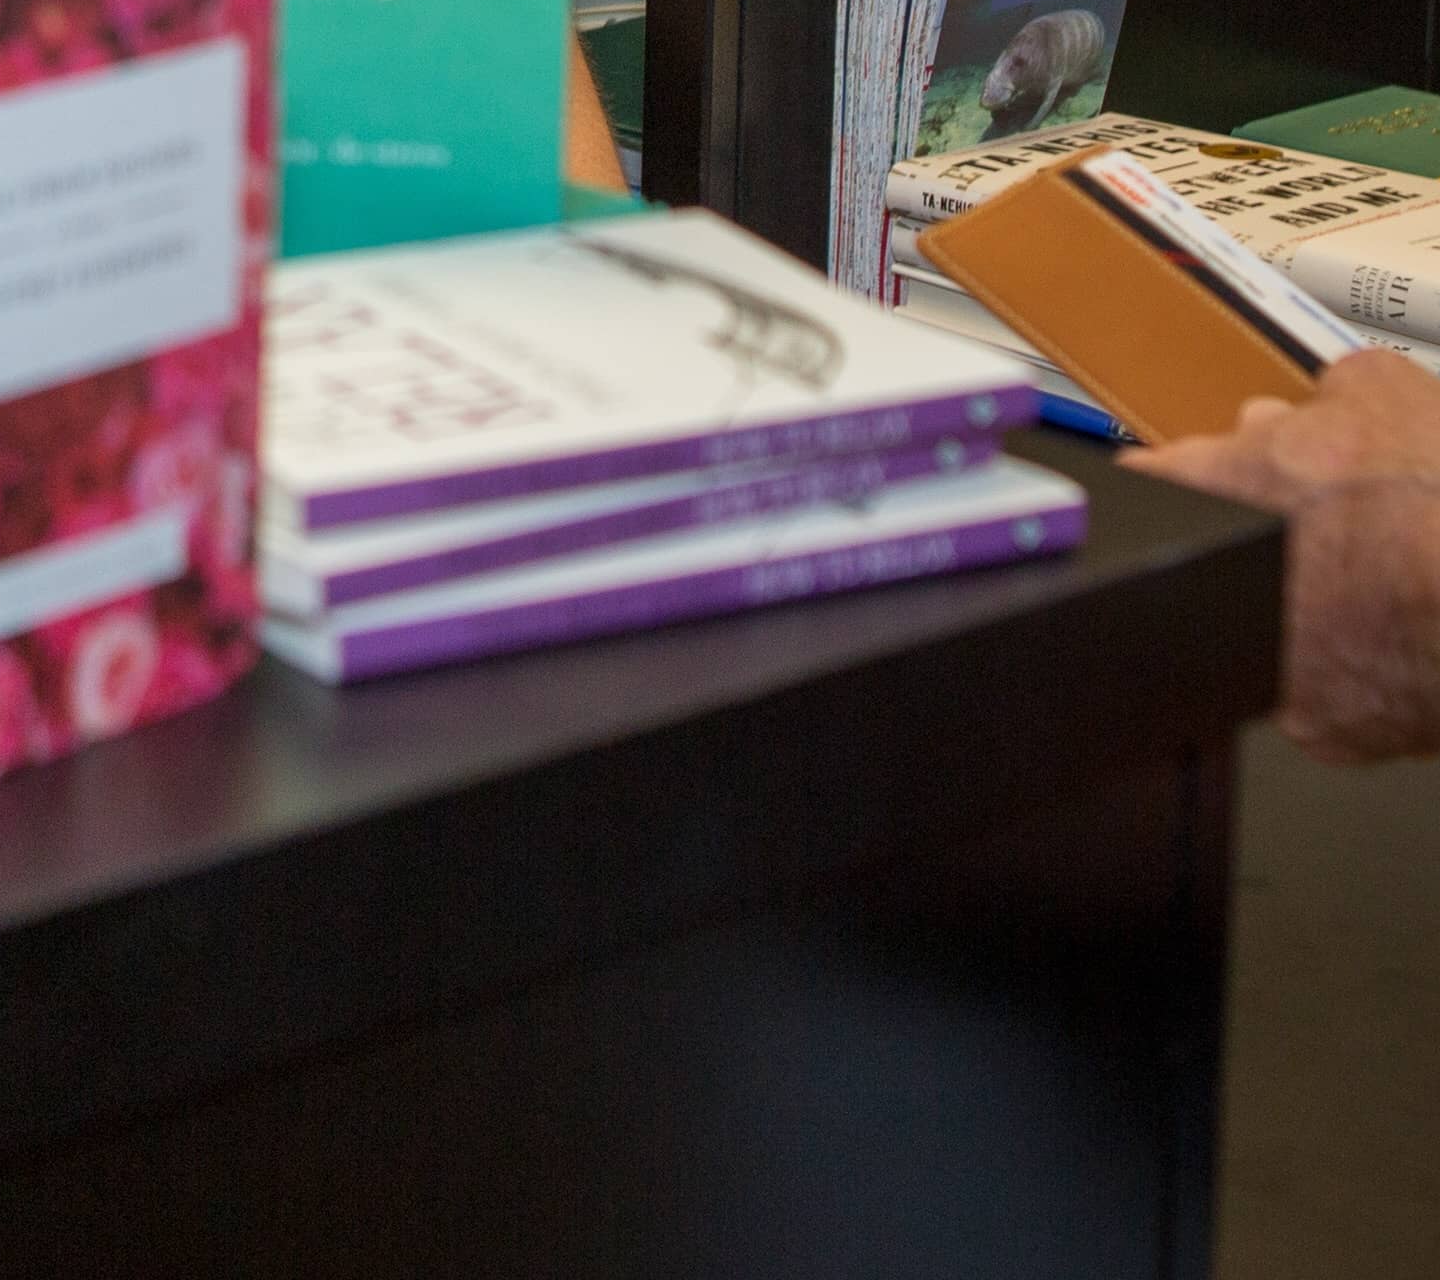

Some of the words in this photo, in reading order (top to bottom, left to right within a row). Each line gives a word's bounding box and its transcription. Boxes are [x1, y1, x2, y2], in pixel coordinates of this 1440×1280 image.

[1247, 166, 1389, 200] WORLD
[1270, 200, 1360, 230] AND
[1346, 185, 1422, 209] ME
[1350, 265, 1369, 313] WHEN
[1388, 275, 1414, 327] AIR
